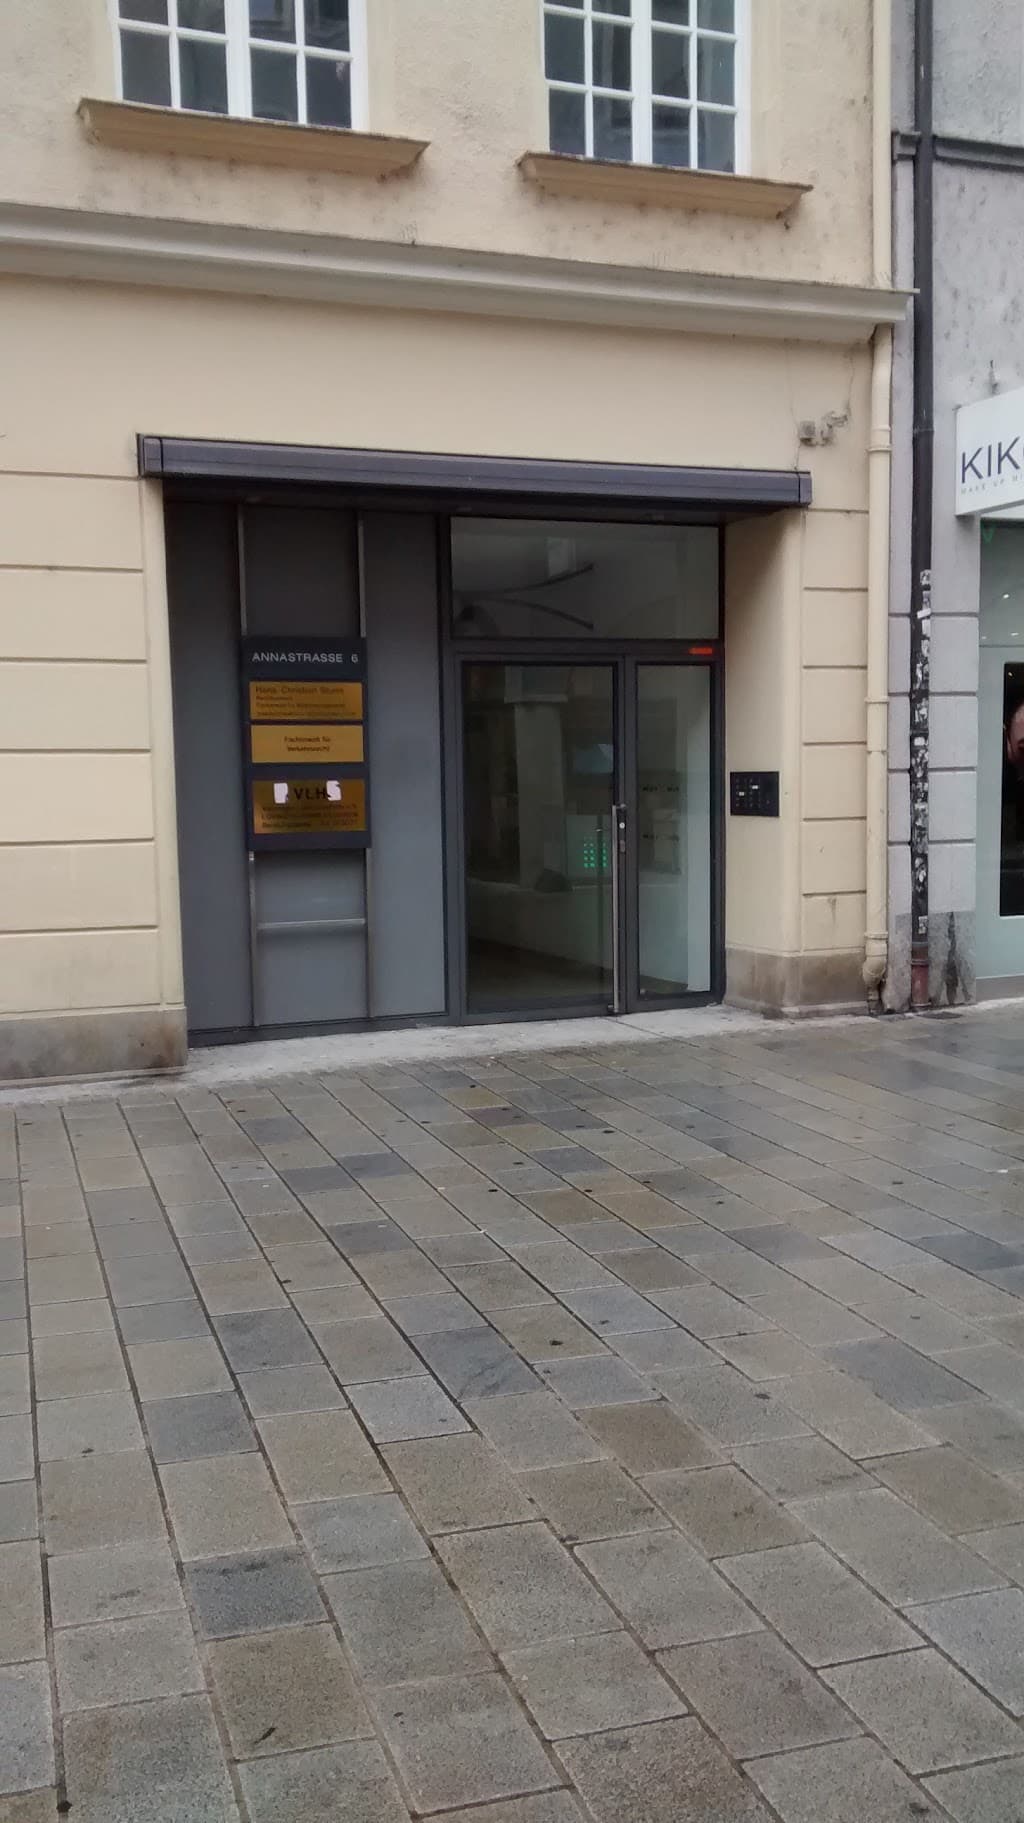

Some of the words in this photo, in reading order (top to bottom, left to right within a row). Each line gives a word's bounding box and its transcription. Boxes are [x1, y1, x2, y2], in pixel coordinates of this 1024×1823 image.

[961, 436, 1024, 484] KIK
[251, 652, 343, 663] ANNASTRASSE
[351, 653, 359, 663] 6
